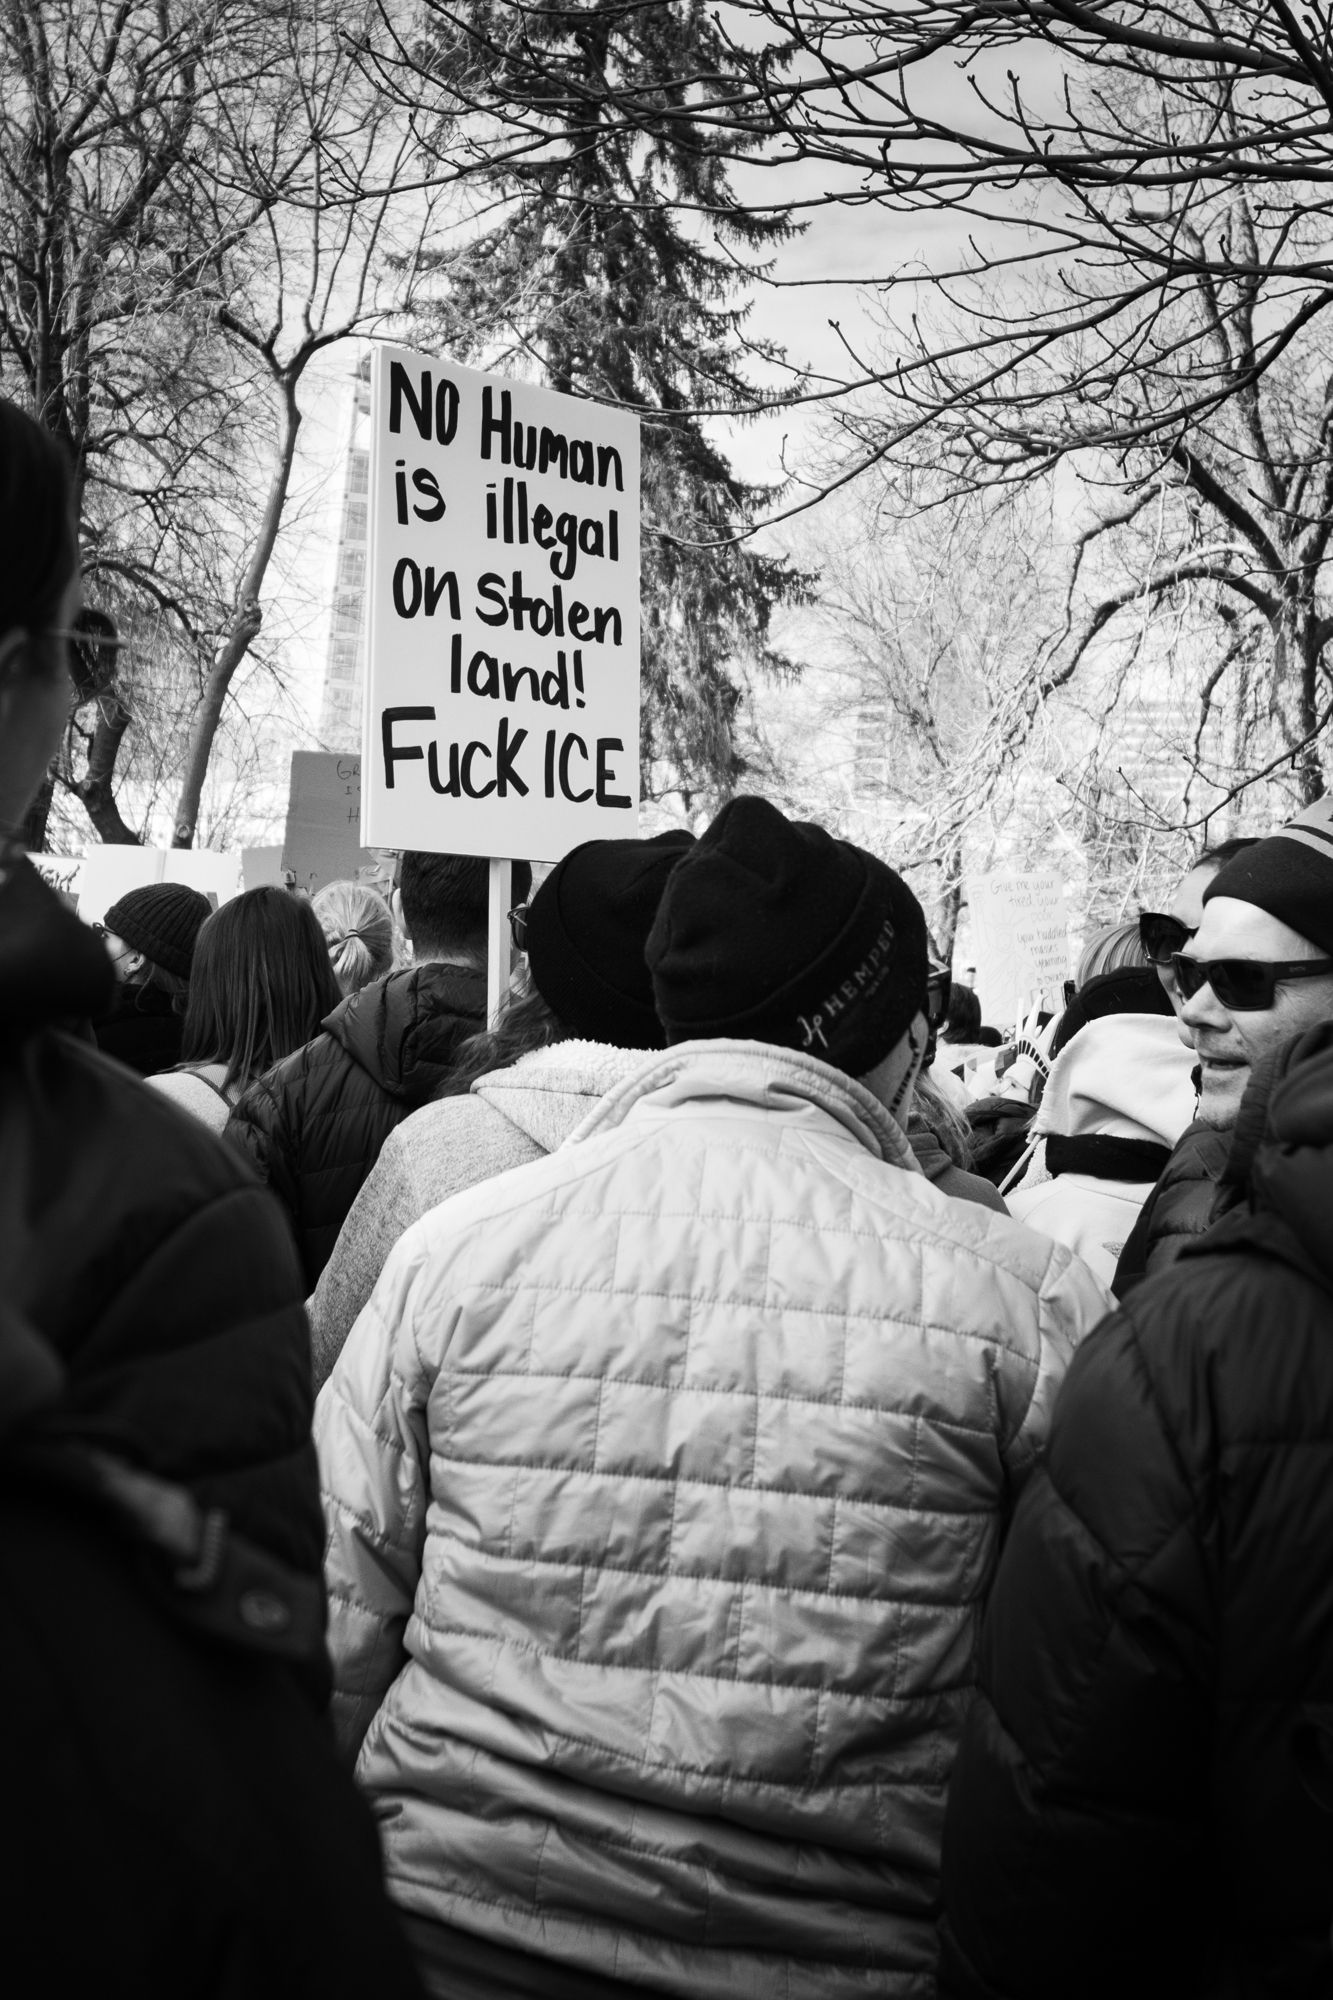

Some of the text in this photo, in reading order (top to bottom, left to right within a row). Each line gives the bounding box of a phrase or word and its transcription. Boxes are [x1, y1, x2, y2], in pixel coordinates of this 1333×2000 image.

[390, 361, 623, 491] NO Human
[396, 460, 618, 580] is illegal
[451, 634, 585, 709] land!
[545, 730, 632, 808] ICE
[1016, 880, 1030, 890] me
[1032, 879, 1055, 896] your
[1037, 896, 1059, 912] your
